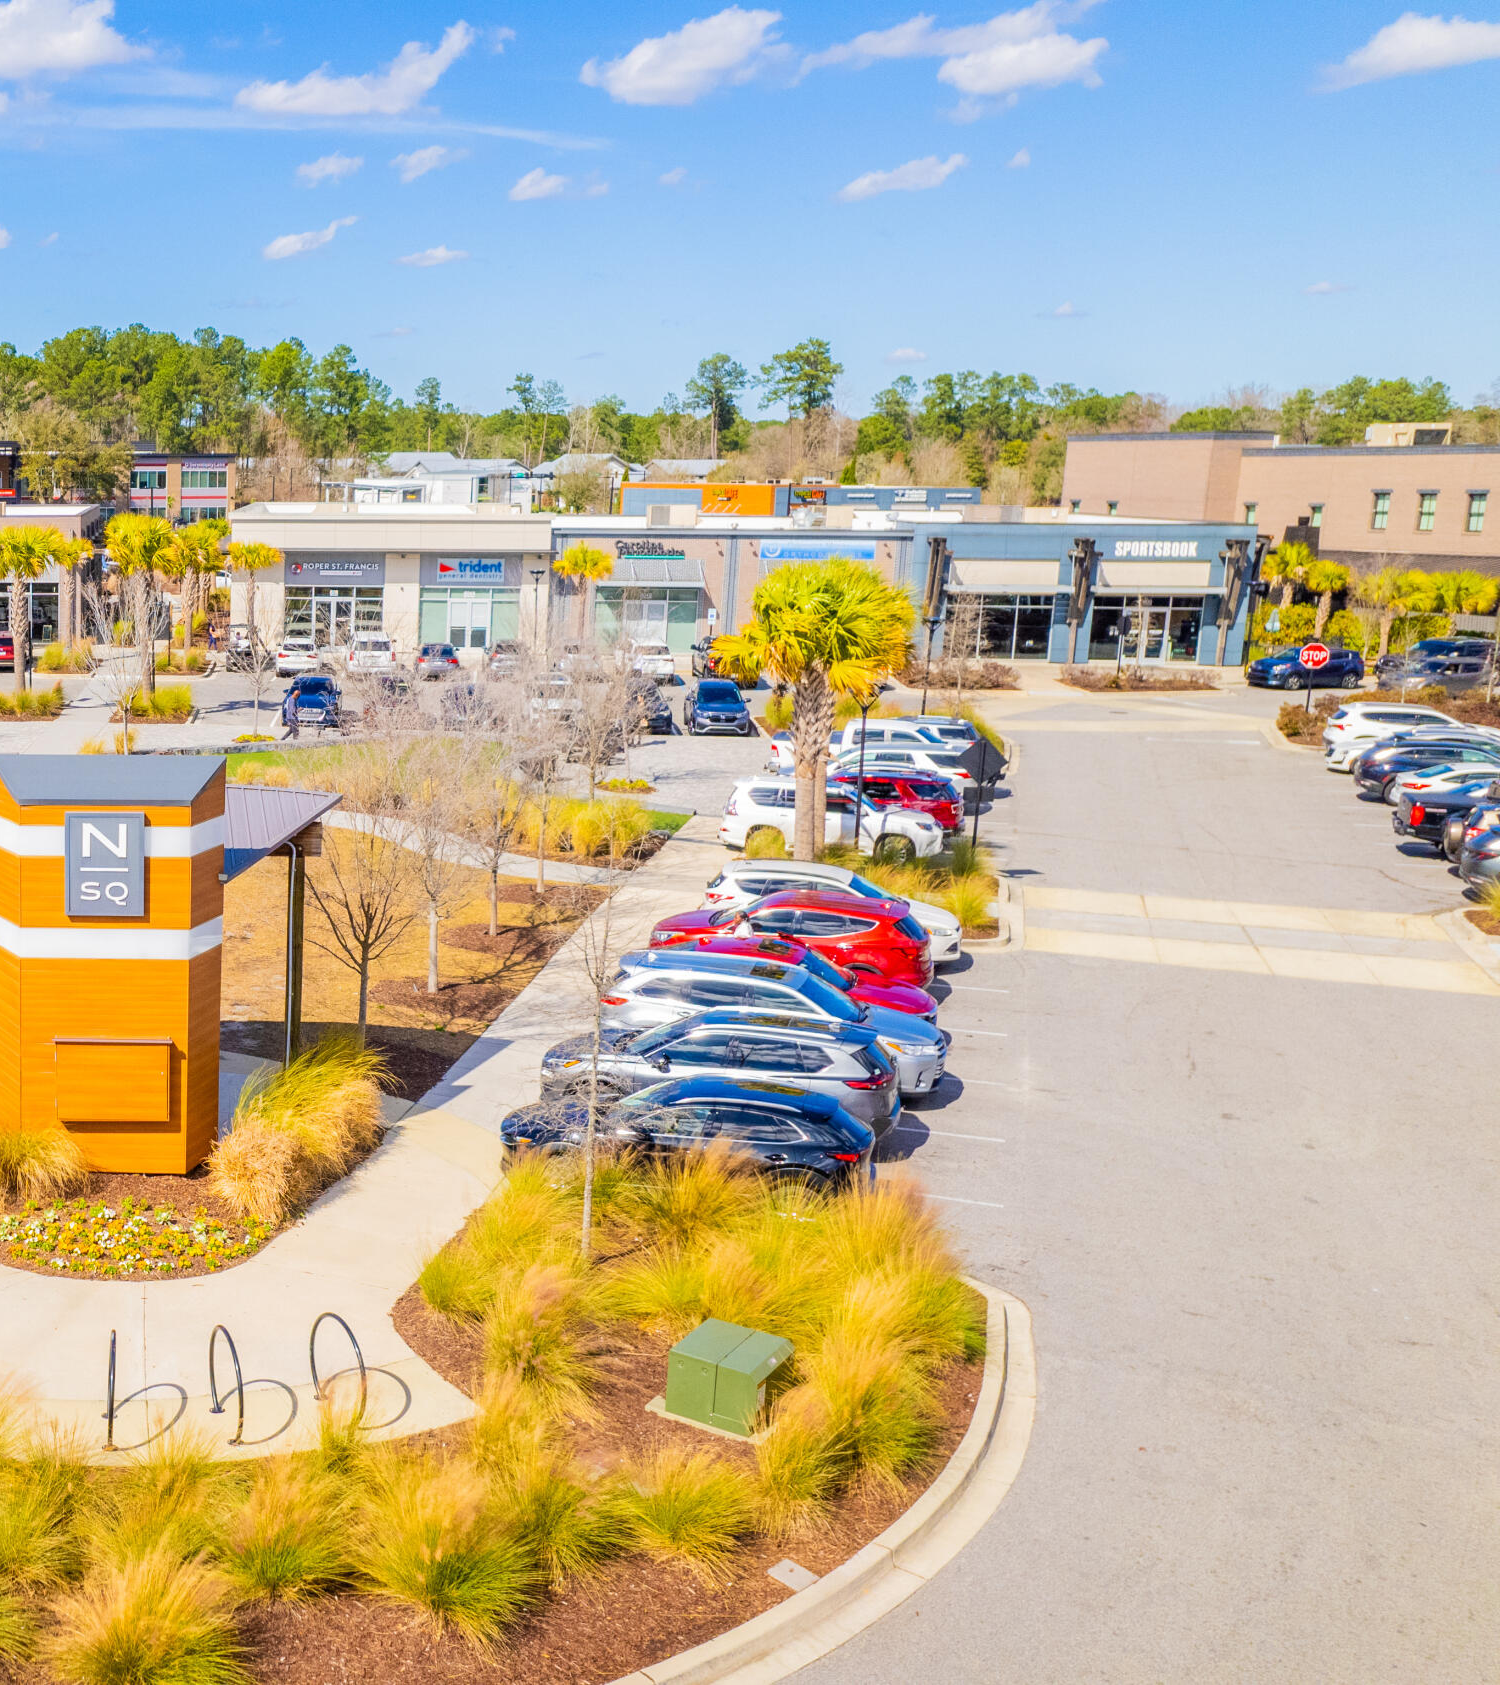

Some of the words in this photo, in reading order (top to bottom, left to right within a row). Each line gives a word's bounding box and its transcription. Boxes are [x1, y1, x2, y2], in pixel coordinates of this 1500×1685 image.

[1115, 541, 1198, 557] SPORTSBOOK
[302, 562, 330, 570] ROPER
[458, 559, 503, 573] trident
[1302, 651, 1327, 661] STOP
[82, 823, 127, 858] N
[80, 881, 129, 906] SQ
